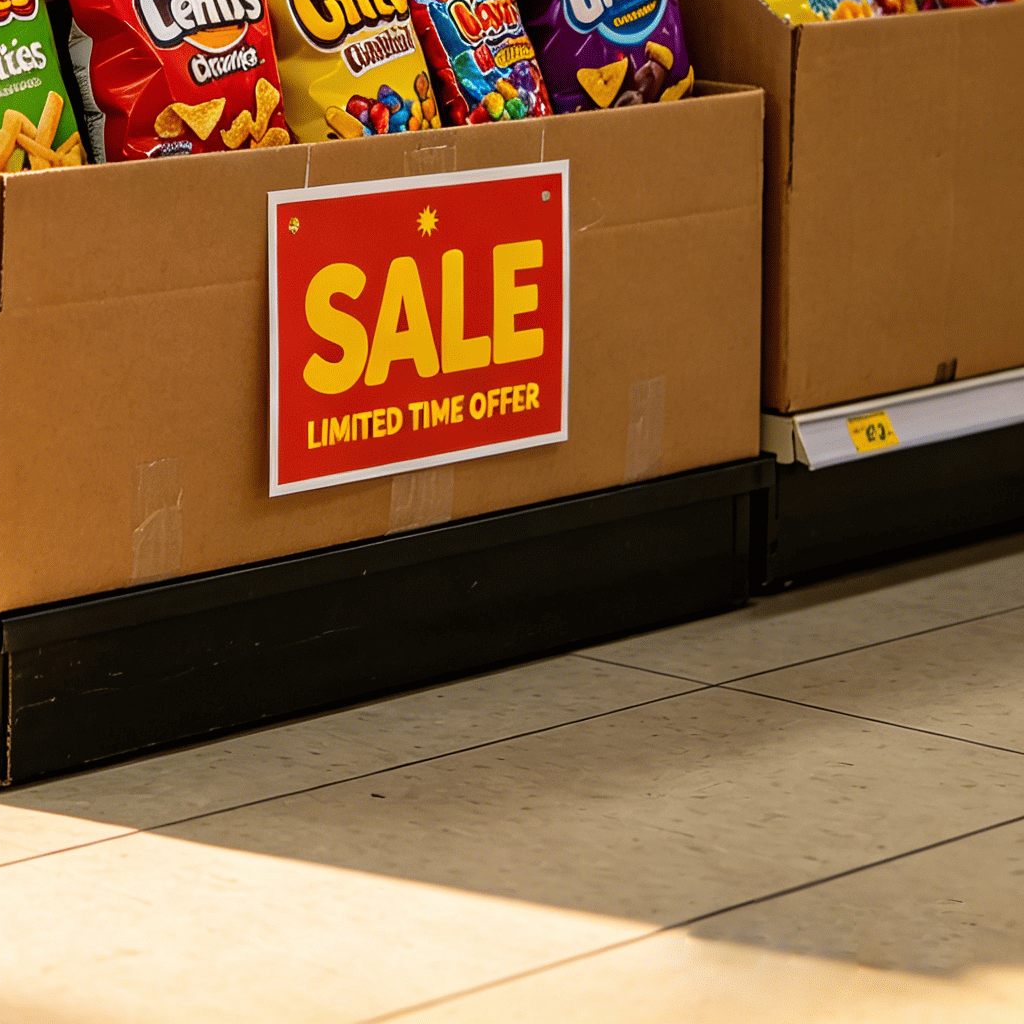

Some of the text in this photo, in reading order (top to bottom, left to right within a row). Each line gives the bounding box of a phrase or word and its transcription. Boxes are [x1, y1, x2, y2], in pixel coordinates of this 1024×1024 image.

[302, 239, 544, 394] SALE
[307, 382, 539, 450] LIMITED TIME OFFER
